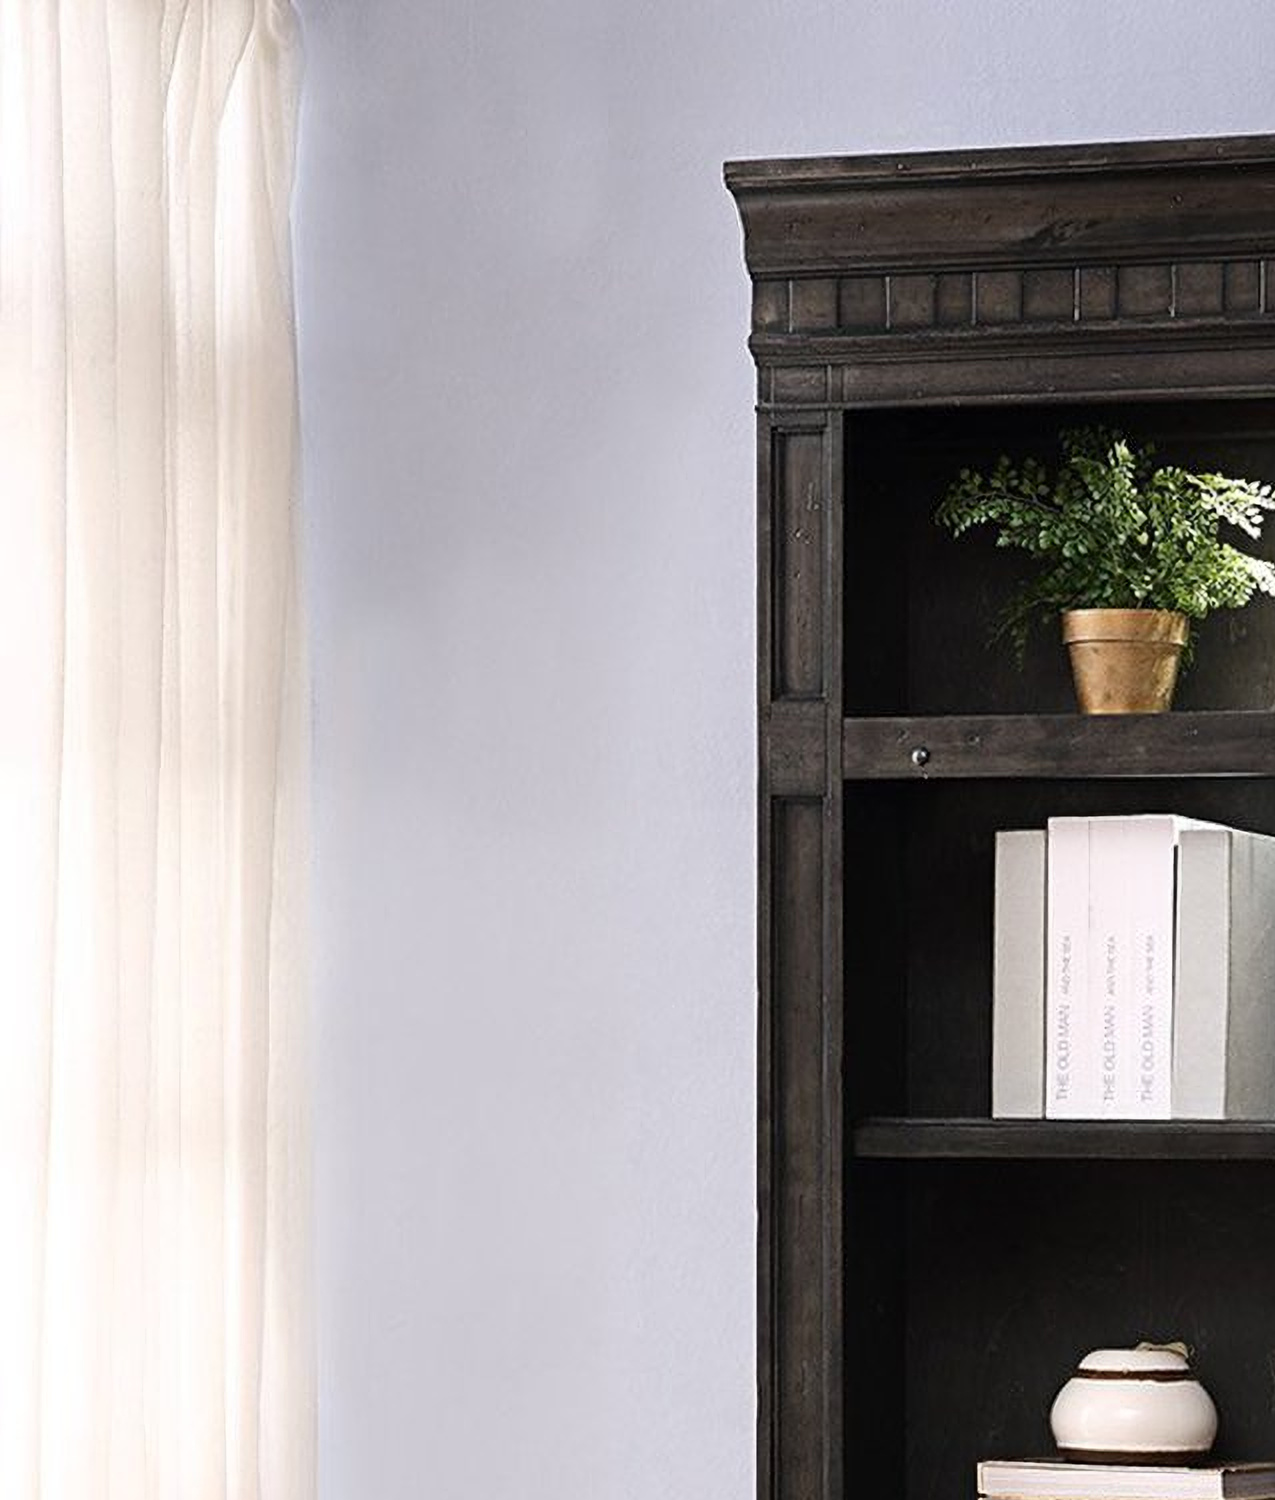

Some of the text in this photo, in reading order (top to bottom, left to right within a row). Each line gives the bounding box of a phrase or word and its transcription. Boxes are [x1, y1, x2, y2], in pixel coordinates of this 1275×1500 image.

[1056, 1005, 1070, 1038] MAN
[1103, 1006, 1115, 1038] MAN
[1141, 1006, 1154, 1038] MAN
[1056, 1041, 1070, 1071] OLD
[1103, 1041, 1115, 1072] OLD
[1141, 1041, 1154, 1072] OLD
[1056, 1074, 1070, 1101] THE
[1103, 1075, 1115, 1101] THE
[1141, 1075, 1154, 1102] THE
